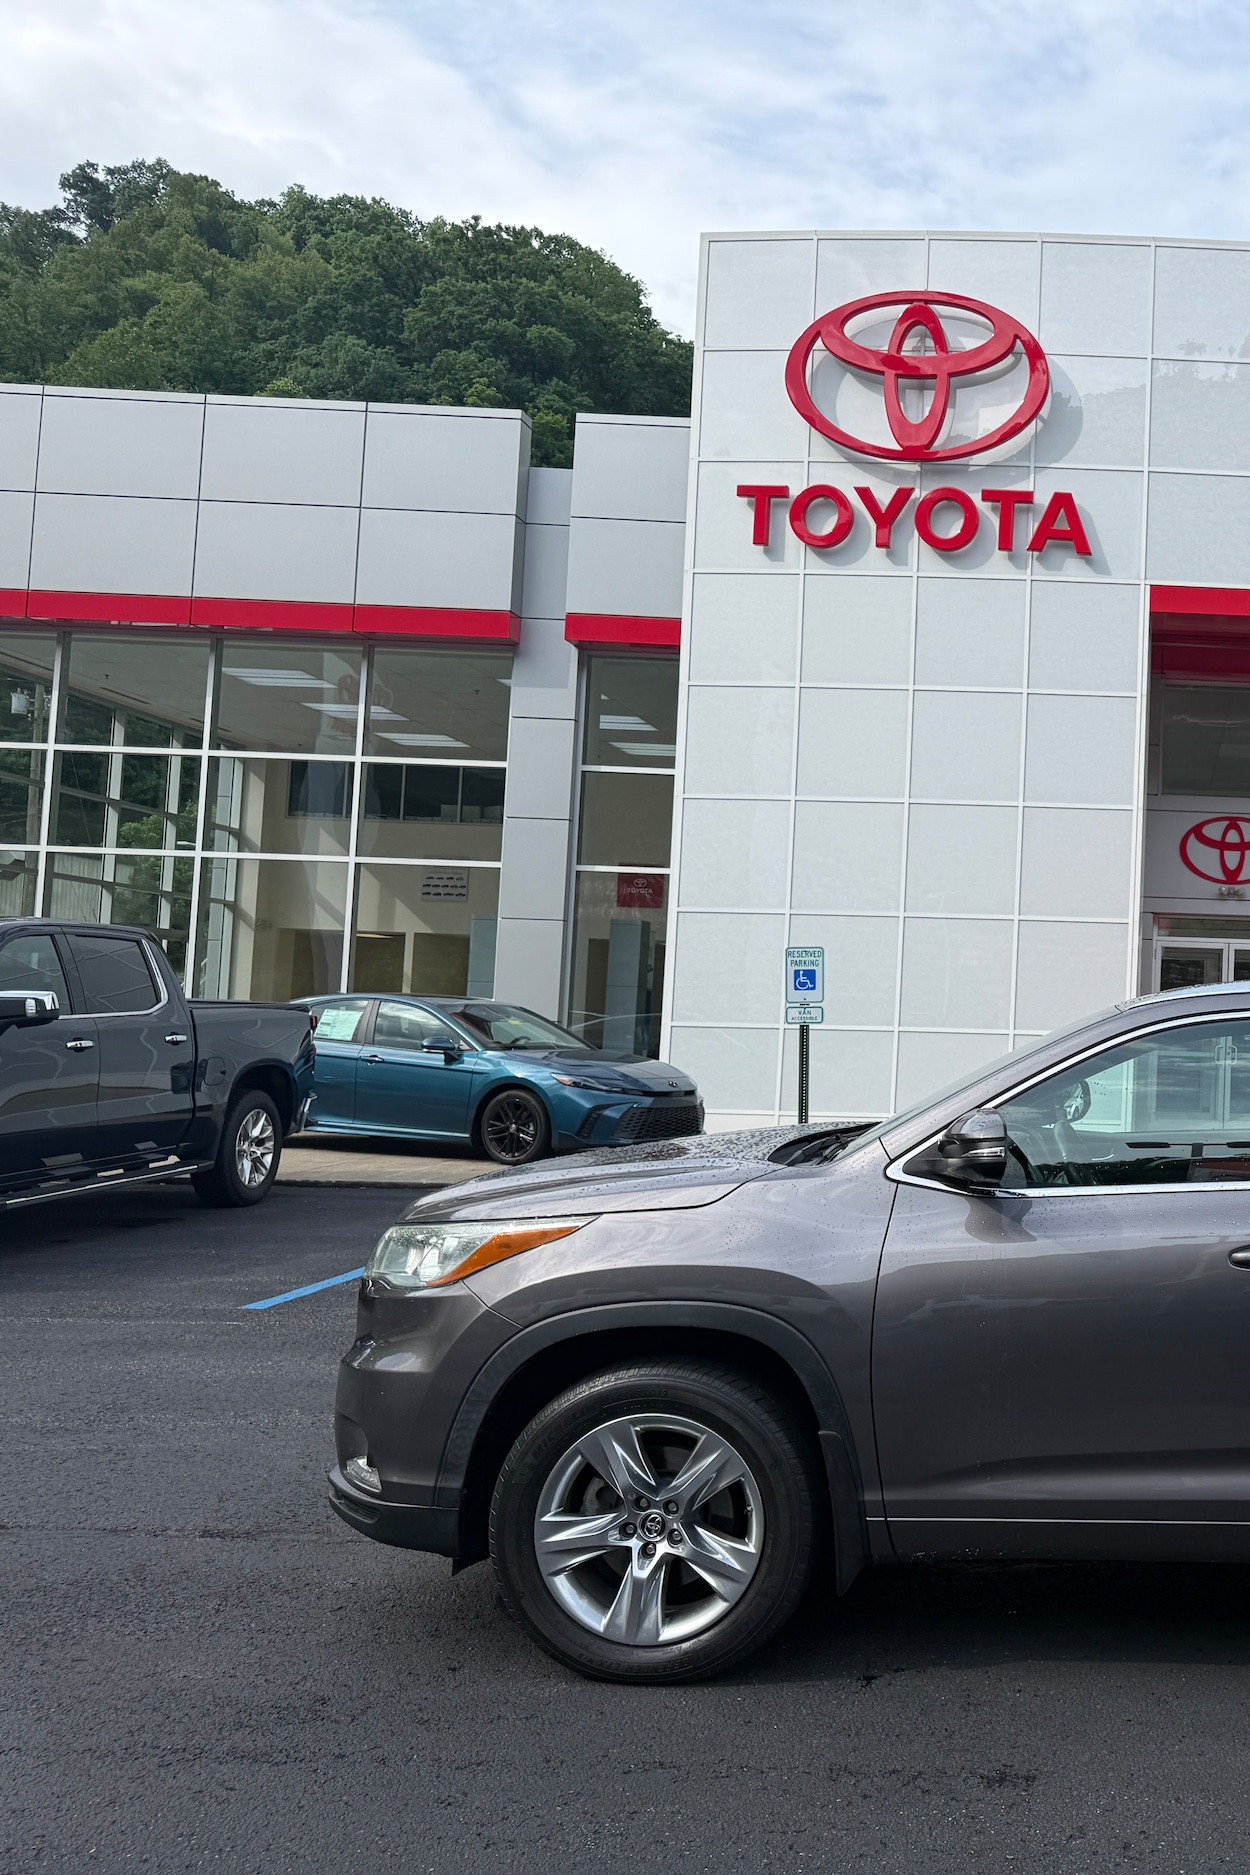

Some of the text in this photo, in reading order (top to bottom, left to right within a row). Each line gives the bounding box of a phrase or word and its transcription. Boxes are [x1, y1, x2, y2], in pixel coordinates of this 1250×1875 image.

[737, 484, 1092, 556] TOYOTA
[787, 950, 822, 959] RESERVED
[790, 959, 819, 967] PARKING
